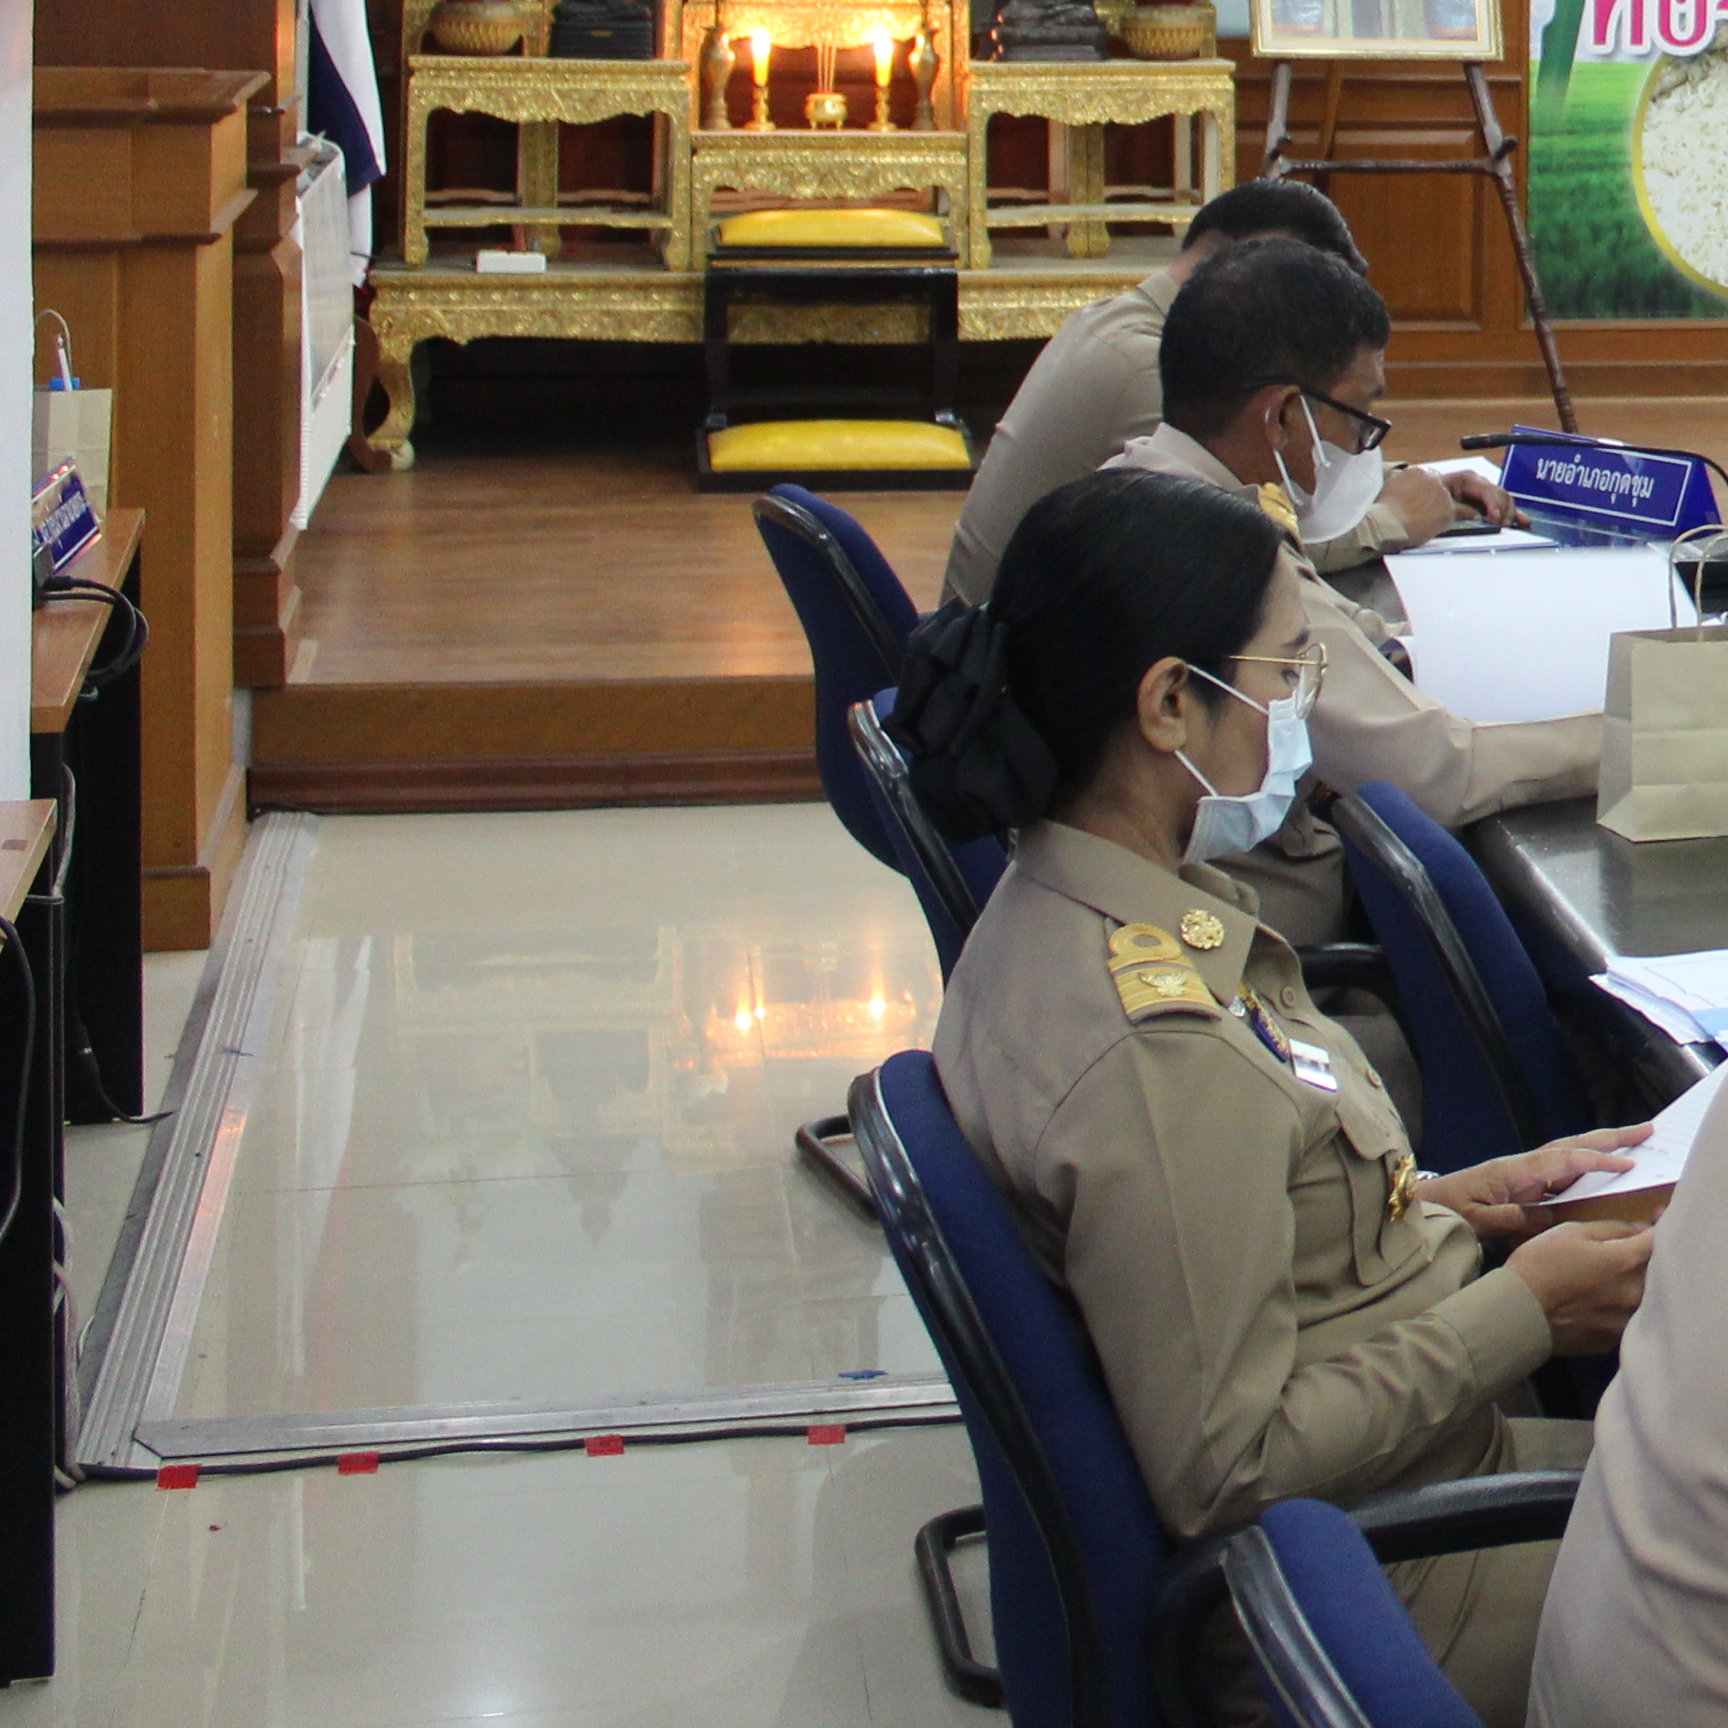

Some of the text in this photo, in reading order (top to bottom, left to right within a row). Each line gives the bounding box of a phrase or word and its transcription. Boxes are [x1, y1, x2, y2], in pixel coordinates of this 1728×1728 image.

[1535, 453, 1655, 508] นายอำเภอกุดชุม
